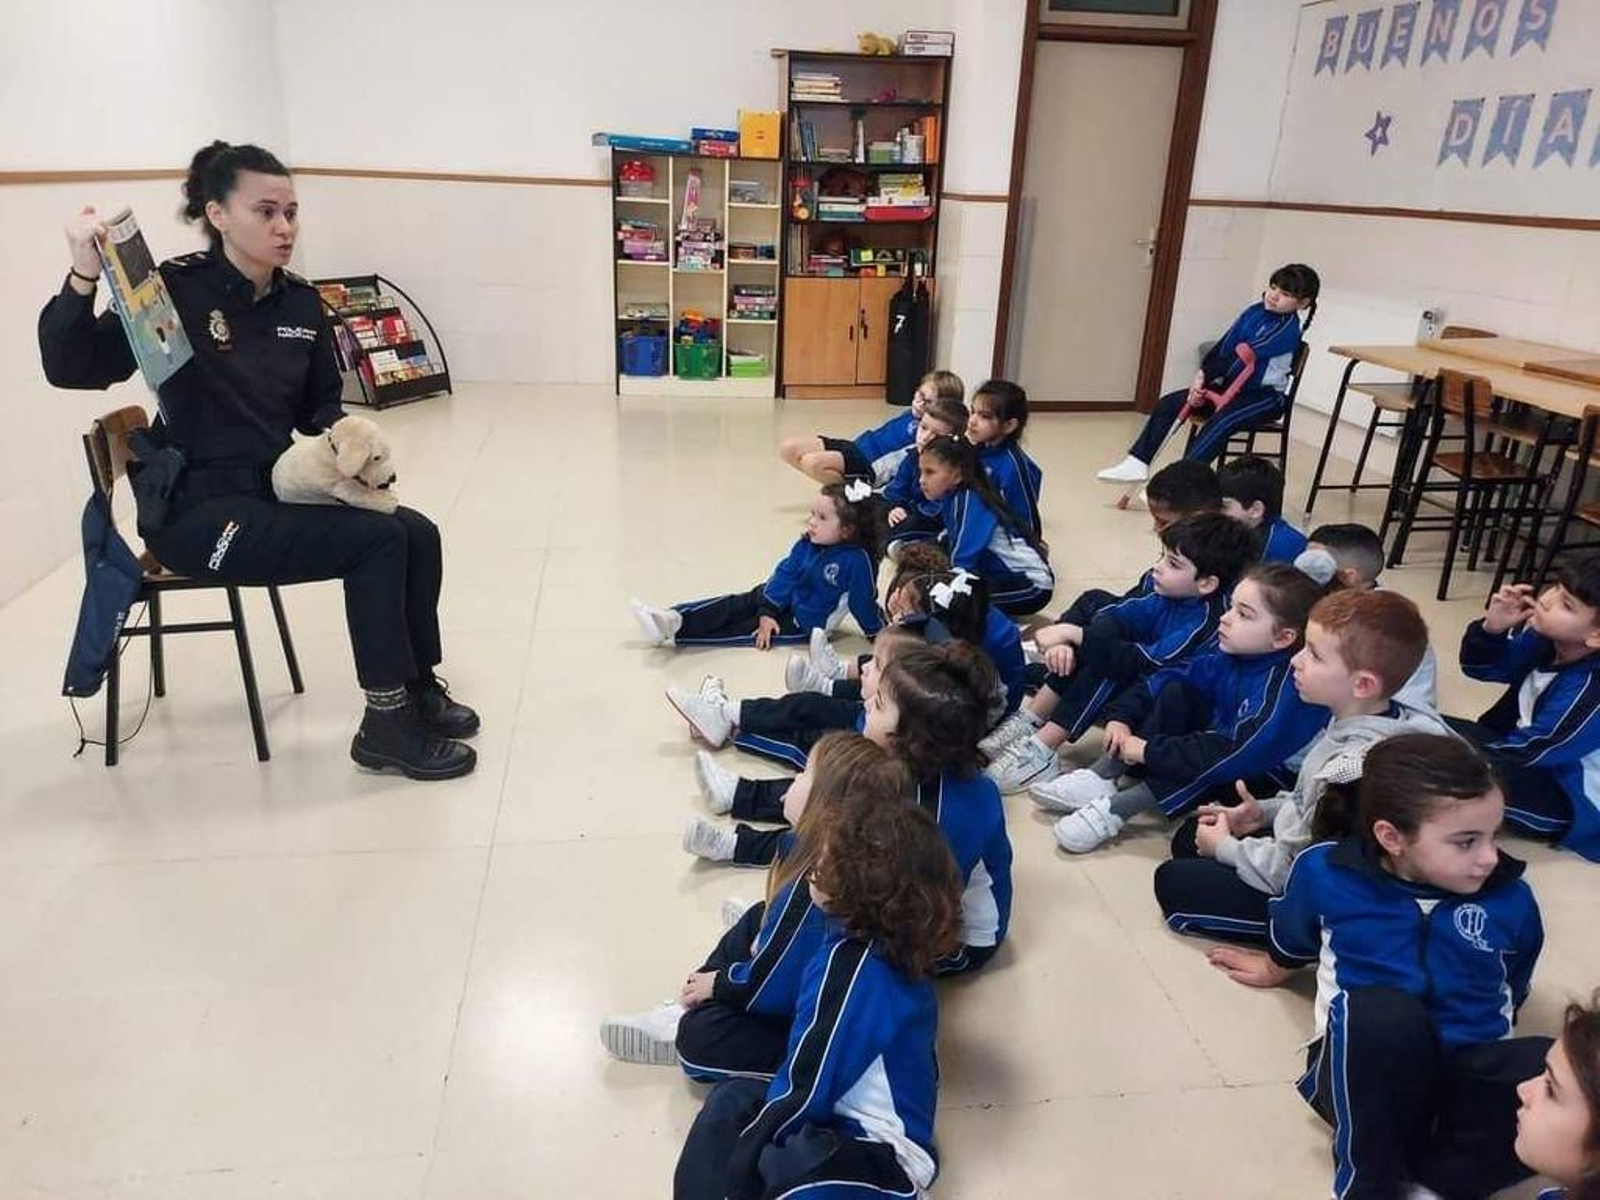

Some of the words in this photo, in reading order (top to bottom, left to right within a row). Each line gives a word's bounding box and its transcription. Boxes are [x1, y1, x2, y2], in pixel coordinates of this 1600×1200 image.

[1323, 0, 1547, 59] BUENOS
[1449, 99, 1576, 147] DÍA
[894, 314, 907, 334] 7
